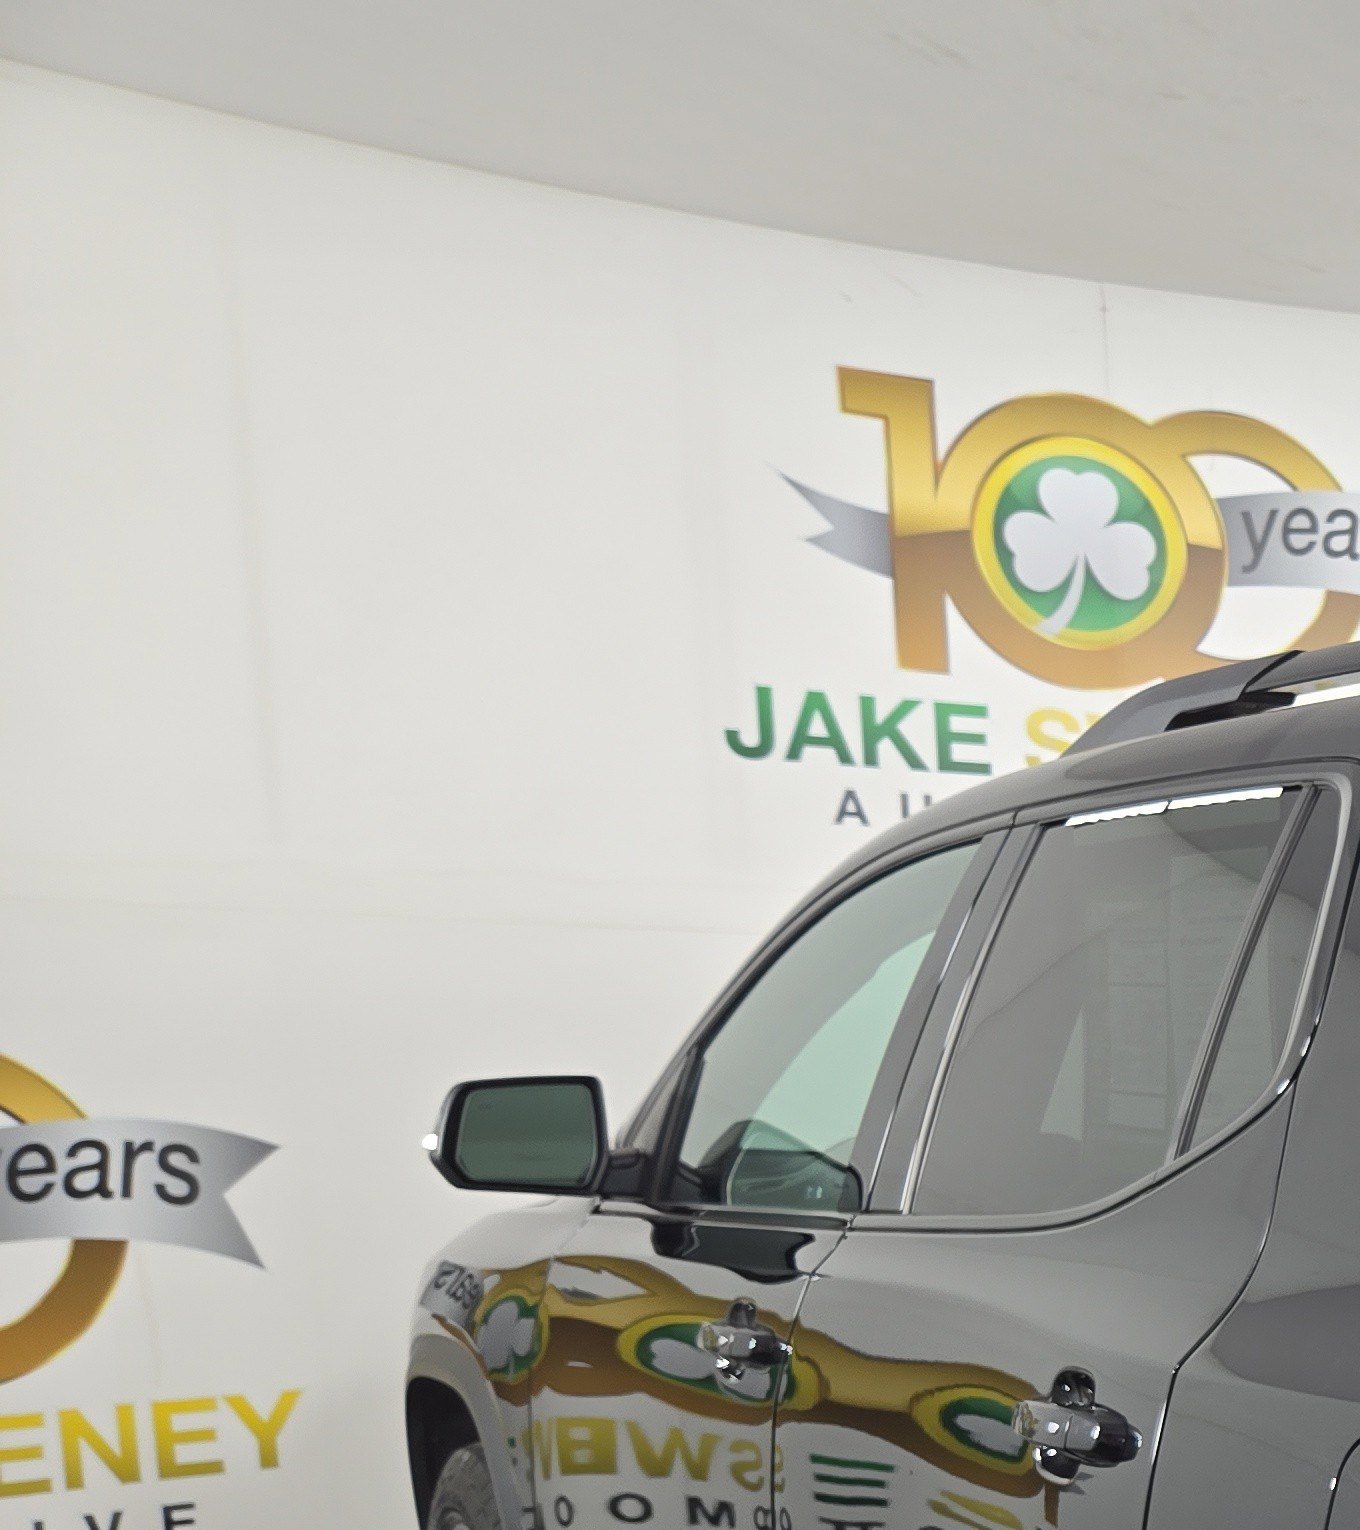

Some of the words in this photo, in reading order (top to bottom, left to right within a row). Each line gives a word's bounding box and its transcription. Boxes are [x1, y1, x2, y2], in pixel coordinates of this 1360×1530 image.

[724, 684, 992, 776] JAKE
[0, 1137, 201, 1206] ears
[0, 1389, 303, 1499] ENEY
